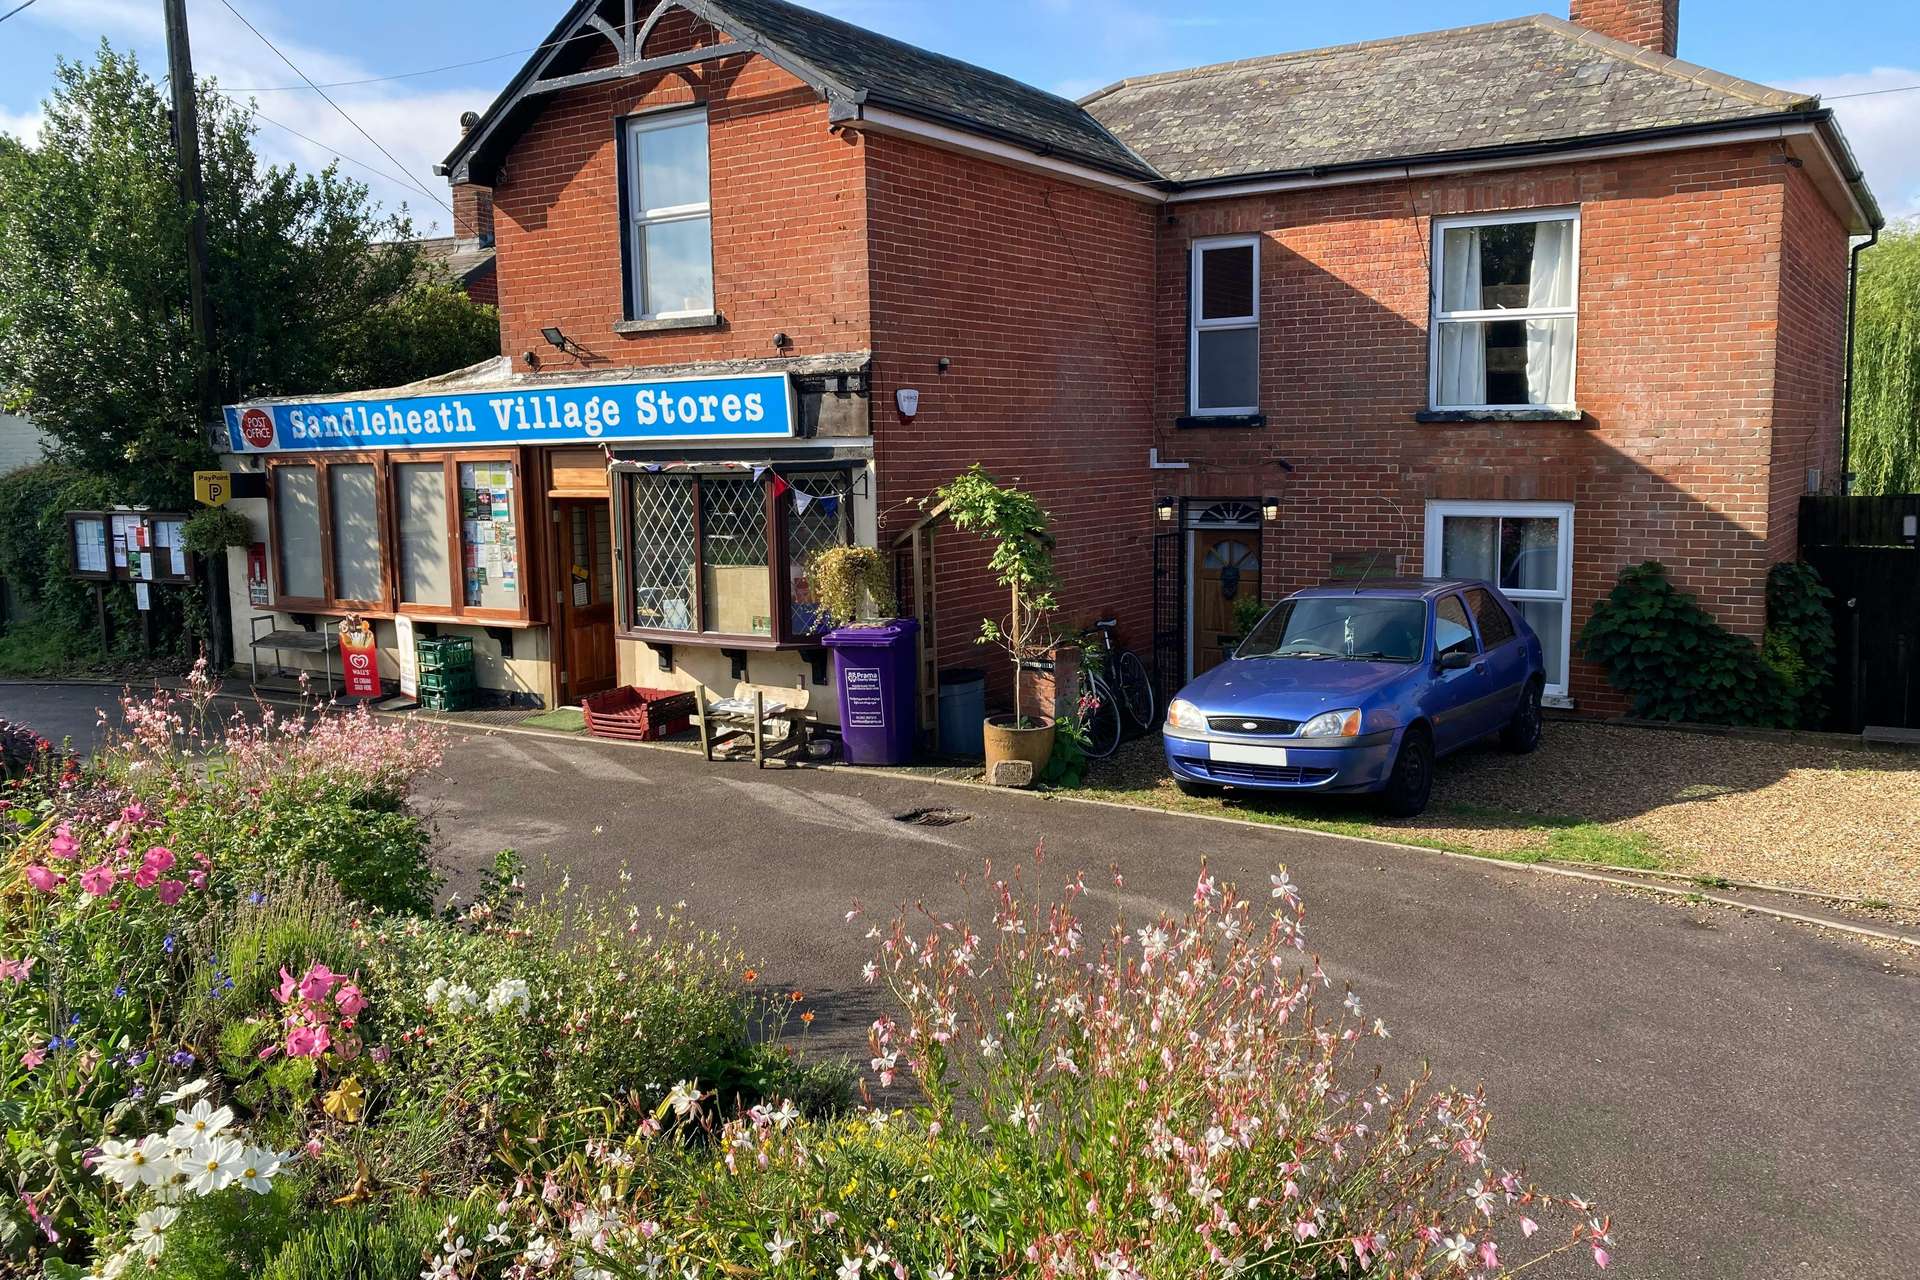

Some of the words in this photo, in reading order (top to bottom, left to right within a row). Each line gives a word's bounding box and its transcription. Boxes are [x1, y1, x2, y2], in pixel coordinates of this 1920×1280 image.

[289, 401, 476, 439] Sandleheath
[489, 395, 621, 436] Village
[635, 389, 764, 426] Stores
[247, 416, 266, 428] POST
[245, 427, 271, 439] OFFICE
[198, 474, 229, 483] PayPoint
